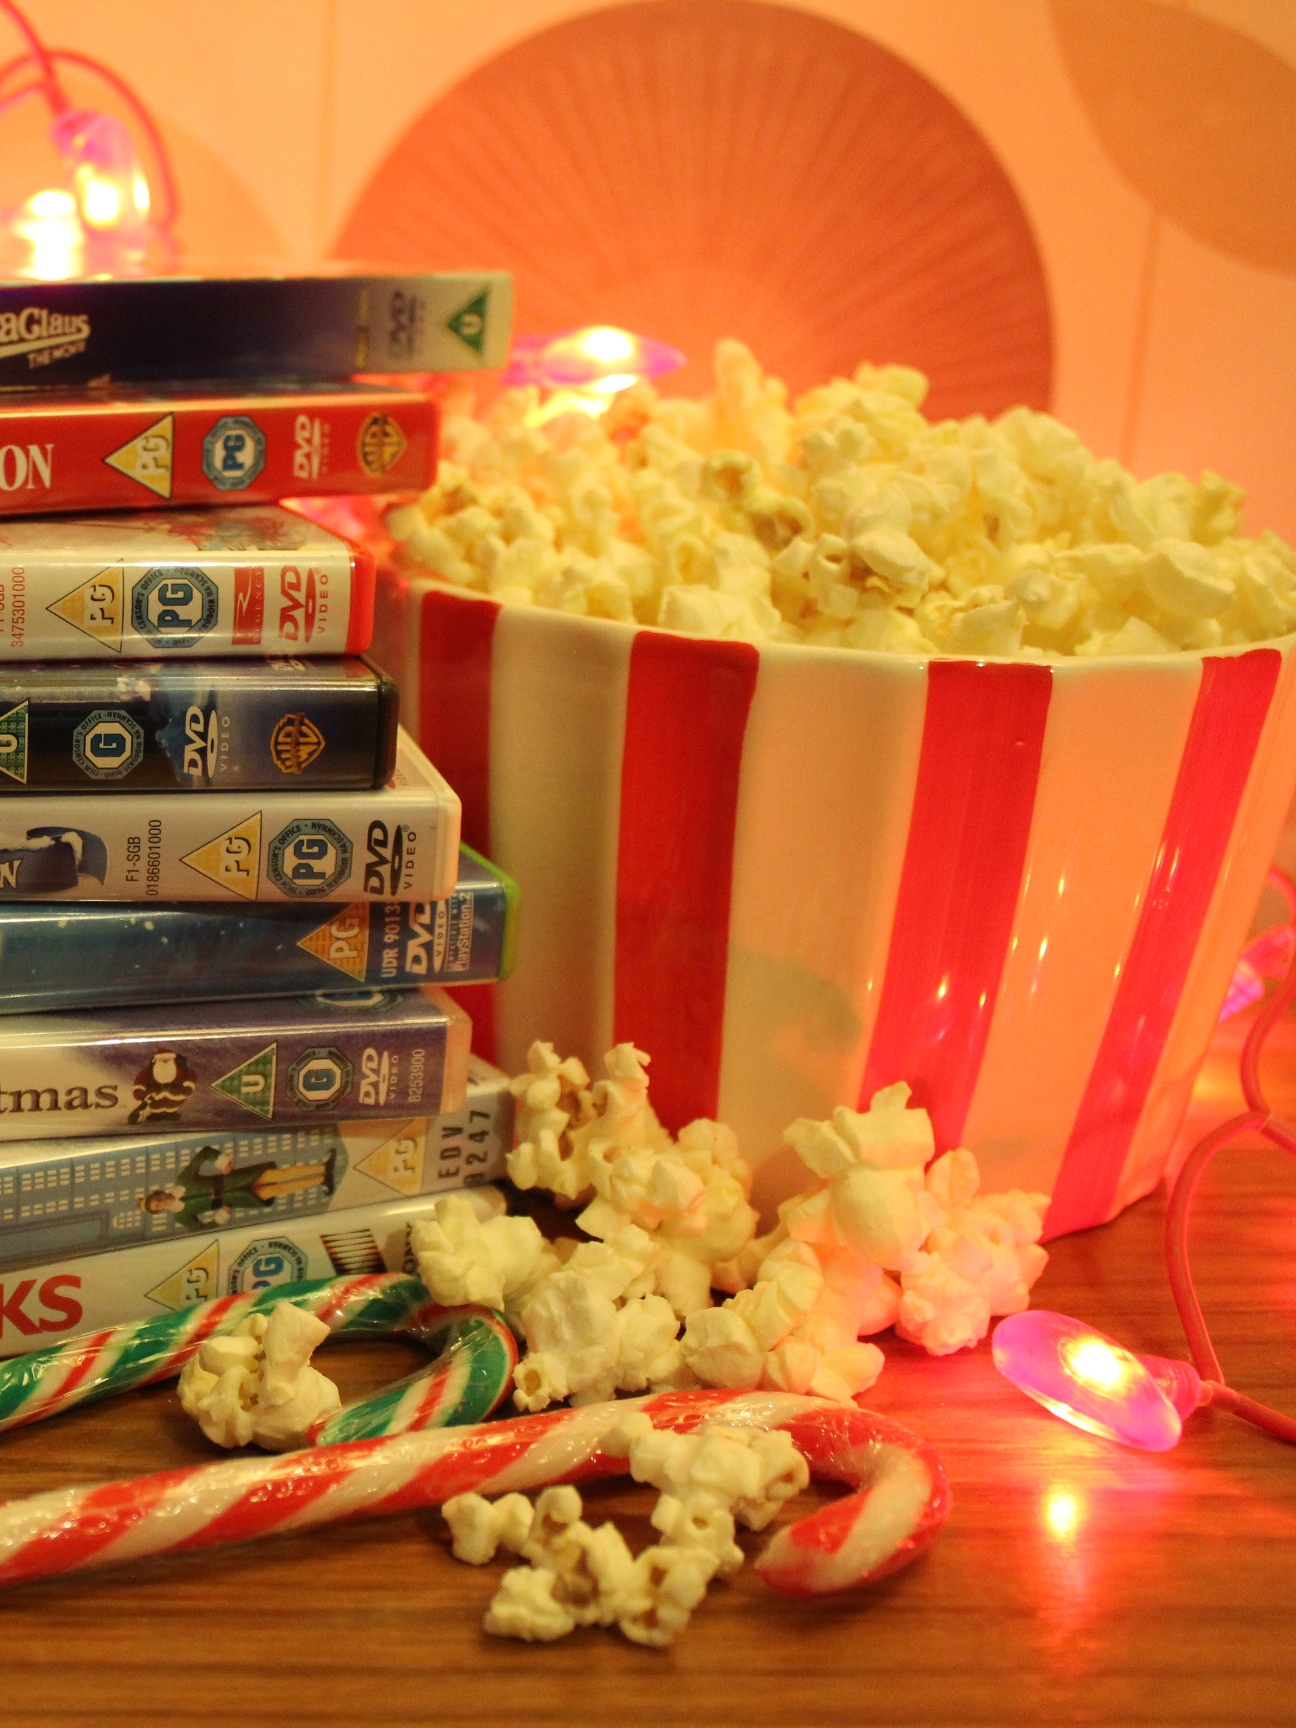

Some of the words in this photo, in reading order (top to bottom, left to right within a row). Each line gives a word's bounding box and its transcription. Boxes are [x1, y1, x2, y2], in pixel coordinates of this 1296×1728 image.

[136, 433, 170, 476] PG
[222, 434, 246, 470] PG
[293, 414, 311, 479] DVD
[12, 567, 26, 648] 3475301000
[90, 583, 115, 625] PG
[157, 583, 193, 628] PG
[279, 565, 304, 641] DVD
[318, 575, 329, 633] VIDEO
[81, 712, 102, 730] OFFICE
[184, 705, 207, 777] DVD
[220, 716, 230, 771] VIDEO
[225, 836, 251, 877] PG
[278, 824, 302, 845] OFFICE
[126, 836, 141, 882] F1-SGB
[146, 819, 162, 896] 0186601000
[292, 839, 328, 879] PG
[364, 819, 391, 896] DVD
[403, 832, 417, 889] VIDEO
[329, 918, 360, 959] PG
[384, 901, 401, 943] 9013
[436, 911, 444, 957] VIDEO
[381, 948, 399, 977] UDR
[241, 1073, 265, 1093] U
[359, 1048, 380, 1105] DVD
[389, 1056, 399, 1099] VIDEO
[394, 1138, 417, 1174] PG
[438, 1126, 464, 1180] EDV
